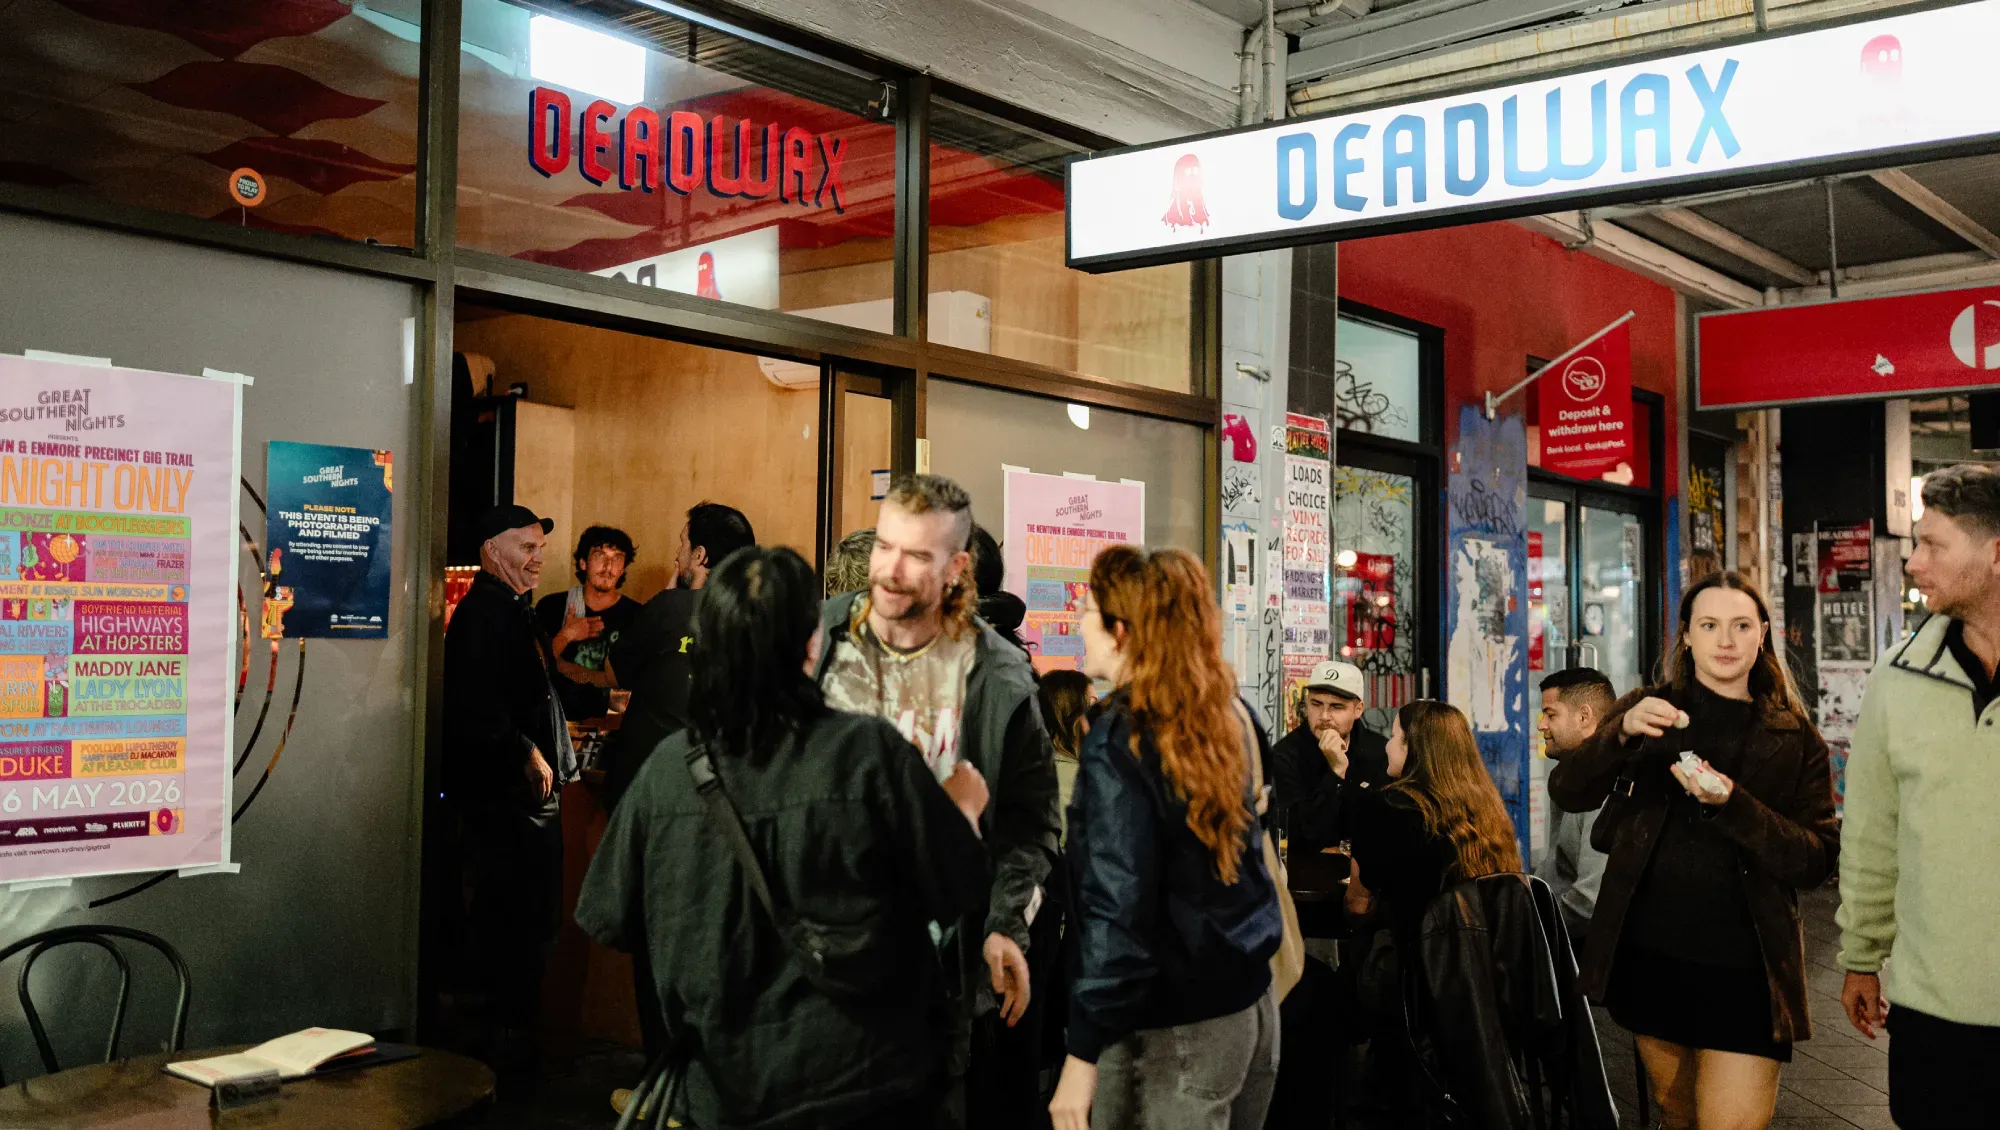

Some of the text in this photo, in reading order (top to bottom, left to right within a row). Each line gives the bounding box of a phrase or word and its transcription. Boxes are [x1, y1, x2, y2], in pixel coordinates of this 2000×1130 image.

[1277, 58, 1741, 221] DEADWAX
[528, 86, 849, 215] DEADWAX
[244, 185, 258, 194] PLAY
[38, 389, 91, 405] GREAT
[0, 404, 89, 422] SOUTHERN
[1559, 405, 1611, 421] Deposit &
[65, 413, 125, 431] NIGHTS
[1548, 420, 1624, 437] withdraw here
[18, 440, 27, 454] &
[31, 441, 81, 458] ENMORE
[85, 445, 140, 462] PRECINCT
[143, 450, 162, 464] GIG
[165, 452, 194, 467] TRAIL
[1547, 439, 1626, 454] Bank local. Bank@Post.
[320, 465, 344, 475] GREAT
[1293, 464, 1322, 485] LOADS
[1, 455, 194, 513] NIGHT ONLY
[303, 473, 342, 484] SOUTHERN
[331, 477, 358, 487] NIGHTS
[1069, 494, 1088, 505] GREAT
[1288, 491, 1326, 510] CHOICE
[303, 504, 356, 514] PLEASE NOTE
[1056, 503, 1088, 517] SOUTHERN
[1080, 509, 1102, 520] NIGHTS
[0, 511, 184, 536] JONZE AT BOOTLEGGERS
[279, 511, 379, 525] THIS EVENT IS BEING
[288, 519, 370, 532] PHOTOGRAPHED
[1292, 509, 1322, 527] VINYL
[298, 529, 360, 539] AND FILMED
[1027, 523, 1035, 533] THE
[1036, 525, 1061, 535] NEWTOWN
[1067, 527, 1086, 537] ENMORE
[1086, 529, 1107, 539] PRECINCT
[1286, 526, 1327, 545] RECORDS
[343, 550, 368, 558] marketing
[1026, 533, 1096, 568] ONE NIGHT
[157, 560, 184, 569] FRAZER
[82, 586, 103, 597] SUN
[106, 586, 164, 598] WORKSHOP
[1291, 586, 1323, 599] MARKETS
[82, 604, 182, 616] BOYFRIEND MATERIAL
[1823, 601, 1865, 616] HOTEL
[81, 615, 183, 634] HIGHWAYS
[80, 635, 183, 651] AT HOPSTERS
[1314, 628, 1327, 643] MAY
[76, 660, 181, 676] MADDY JANE
[1324, 669, 1339, 681] D
[75, 678, 182, 699] LADY LYON
[75, 699, 182, 711] AT THE TROCADERO
[0, 719, 181, 738] ON AT PALOMINO LOUNGE
[33, 745, 64, 753] FRIENDS
[130, 752, 139, 760] DJ
[141, 750, 177, 759] MACARONI
[1, 755, 64, 776] DUKE
[81, 759, 177, 772] AT PLEASURE CLUB
[32, 783, 105, 812] MAY
[109, 779, 181, 806] 2026
